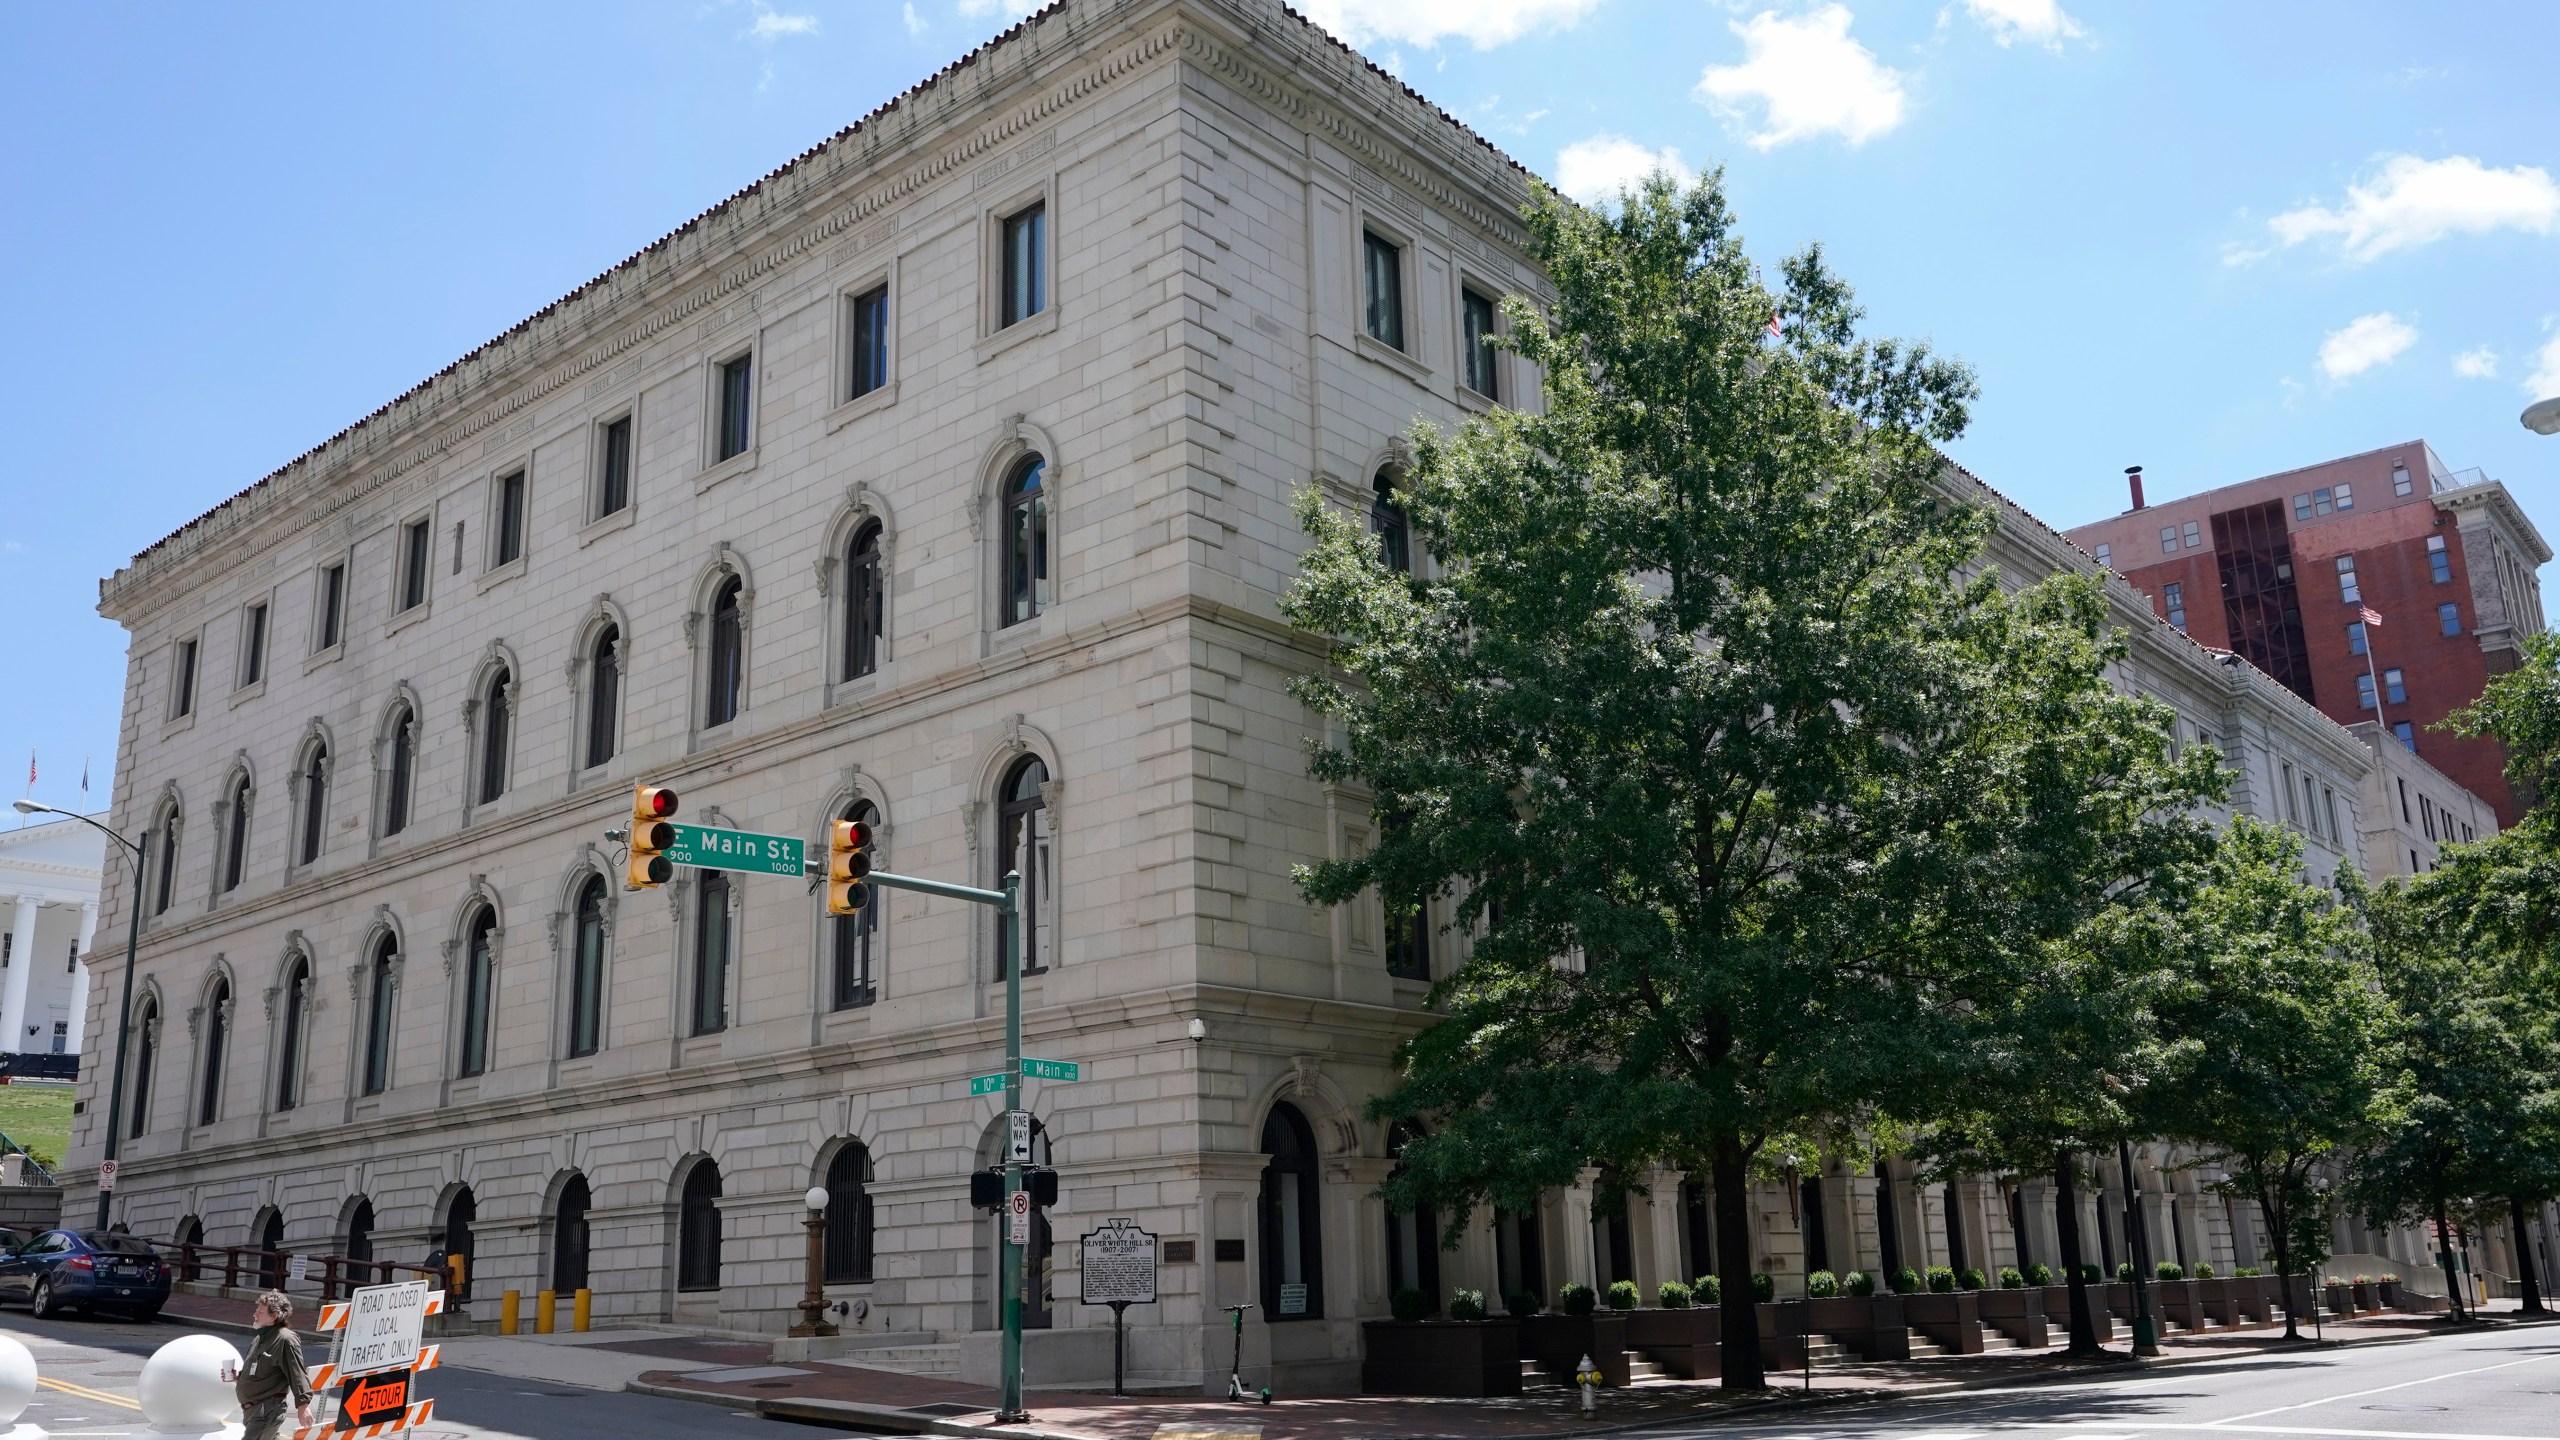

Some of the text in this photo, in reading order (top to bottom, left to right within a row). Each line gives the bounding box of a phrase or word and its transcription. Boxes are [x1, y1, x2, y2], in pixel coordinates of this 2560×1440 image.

[701, 831, 757, 856] Main
[767, 840, 796, 861] St.
[670, 850, 692, 862] 900
[771, 862, 796, 874] 1000
[1024, 1063, 1028, 1072] E
[1036, 1062, 1060, 1077] Main
[1064, 1072, 1075, 1080] 1000
[973, 1082, 977, 1091] N
[1013, 1115, 1027, 1128] ONE
[1013, 1129, 1028, 1141] WAY
[360, 1289, 419, 1314] ROAD CLOSED
[373, 1315, 398, 1337] LOCAL
[350, 1337, 413, 1366] TRAFFIC ONLY
[360, 1385, 401, 1411] DETOUR
